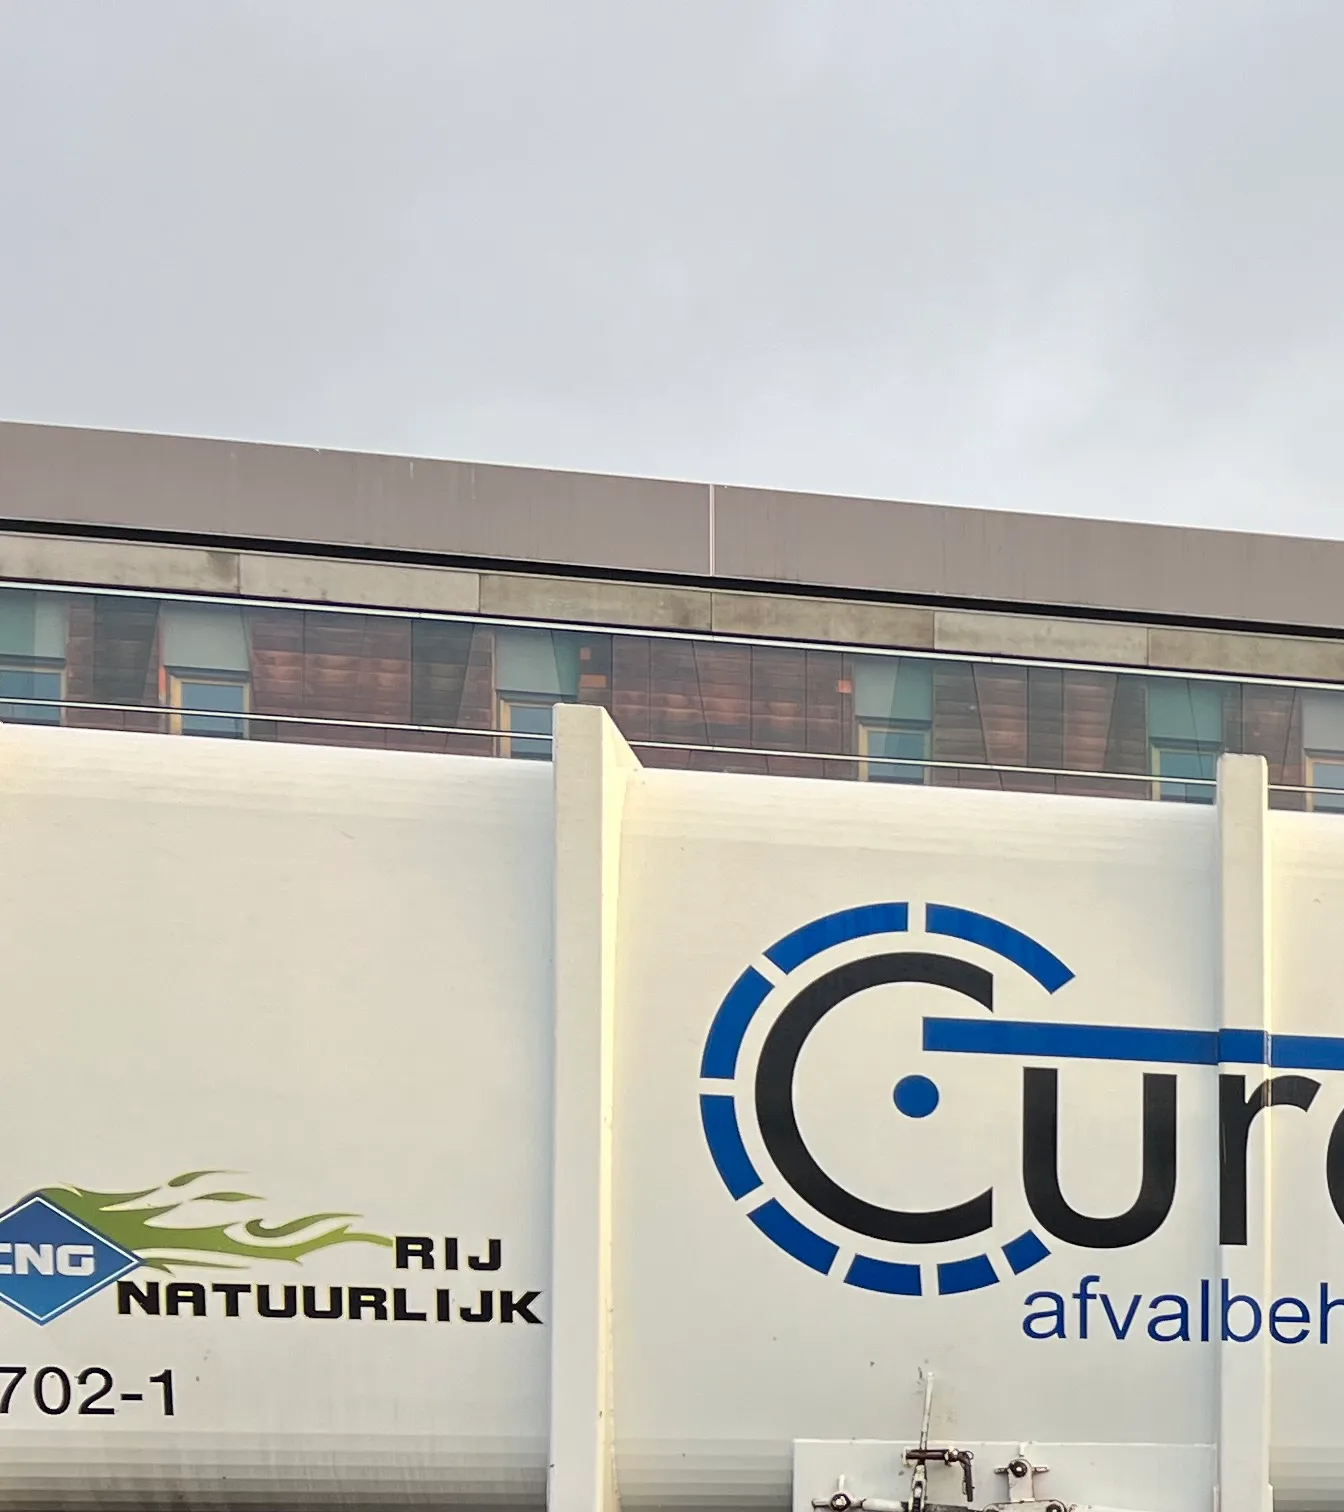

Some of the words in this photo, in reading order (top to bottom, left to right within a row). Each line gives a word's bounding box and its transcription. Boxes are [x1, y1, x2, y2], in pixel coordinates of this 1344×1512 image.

[395, 1235, 502, 1272] RIJ
[117, 1280, 544, 1325] NATUURLIJK
[0, 1366, 175, 1416] 702-1
